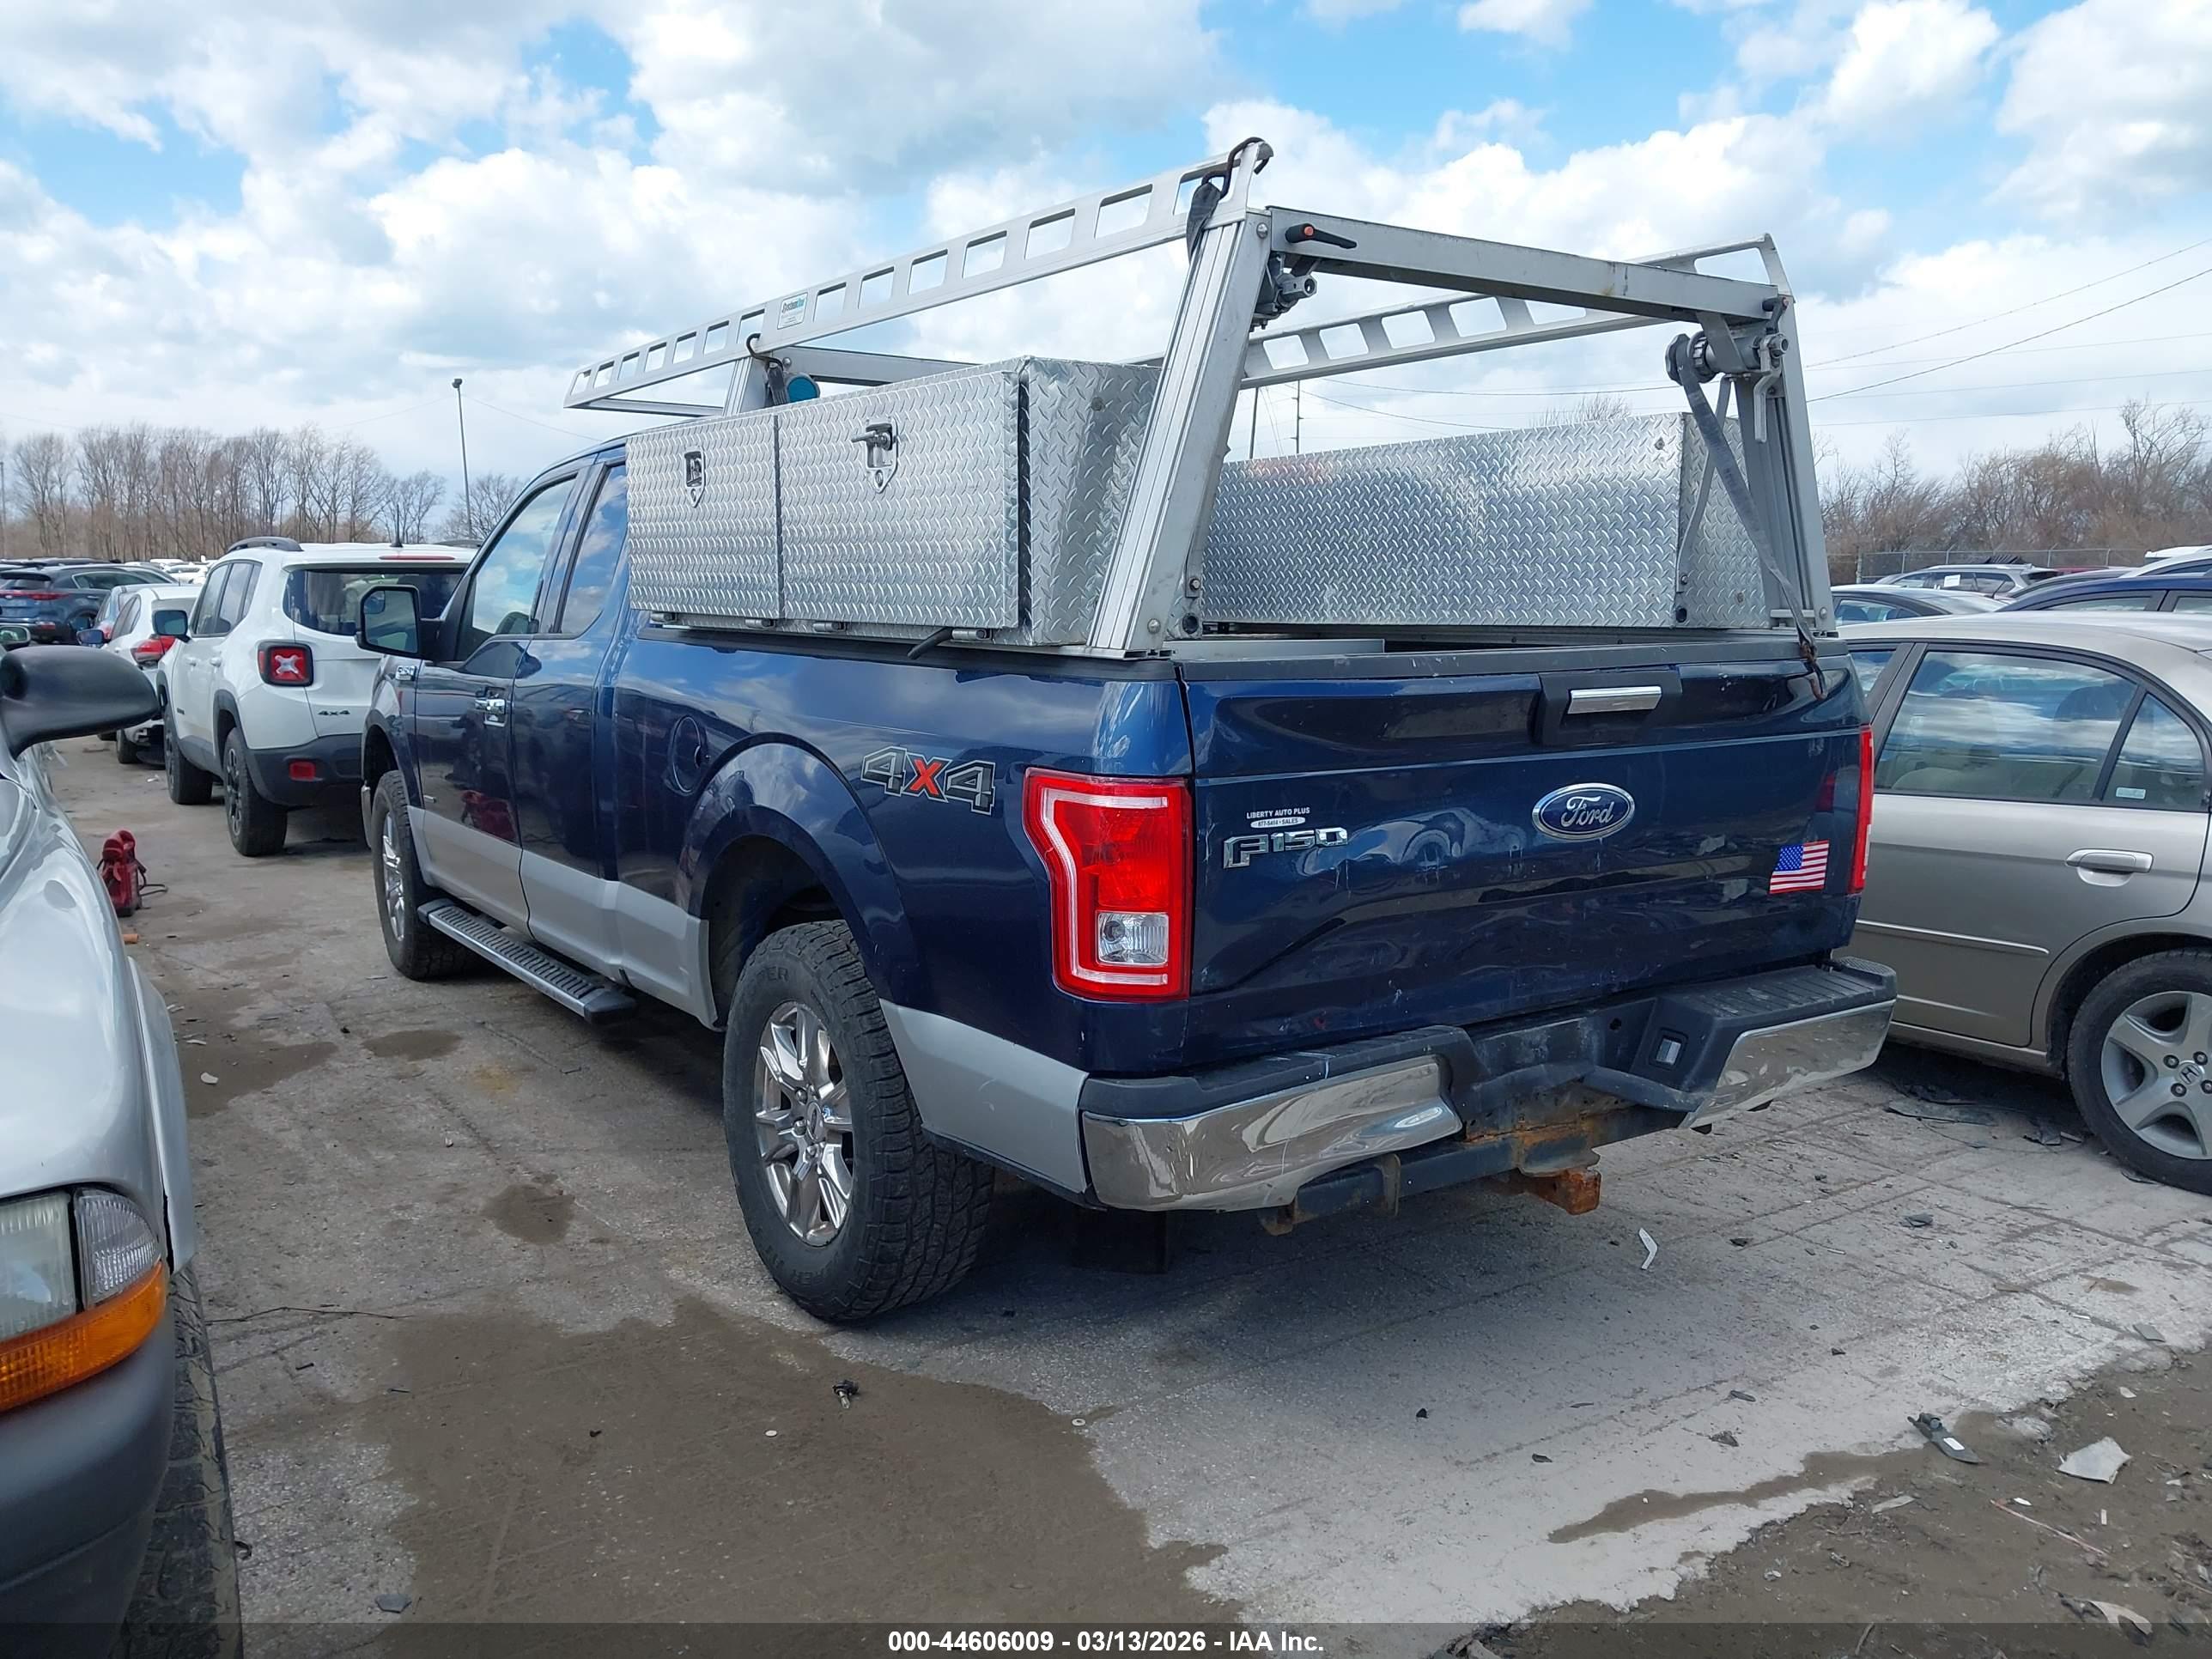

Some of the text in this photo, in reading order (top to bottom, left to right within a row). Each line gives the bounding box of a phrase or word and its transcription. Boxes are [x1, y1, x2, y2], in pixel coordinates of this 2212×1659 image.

[1246, 806, 1310, 819] LIBERTY AUTO PLUS
[1561, 796, 1614, 827] Ford
